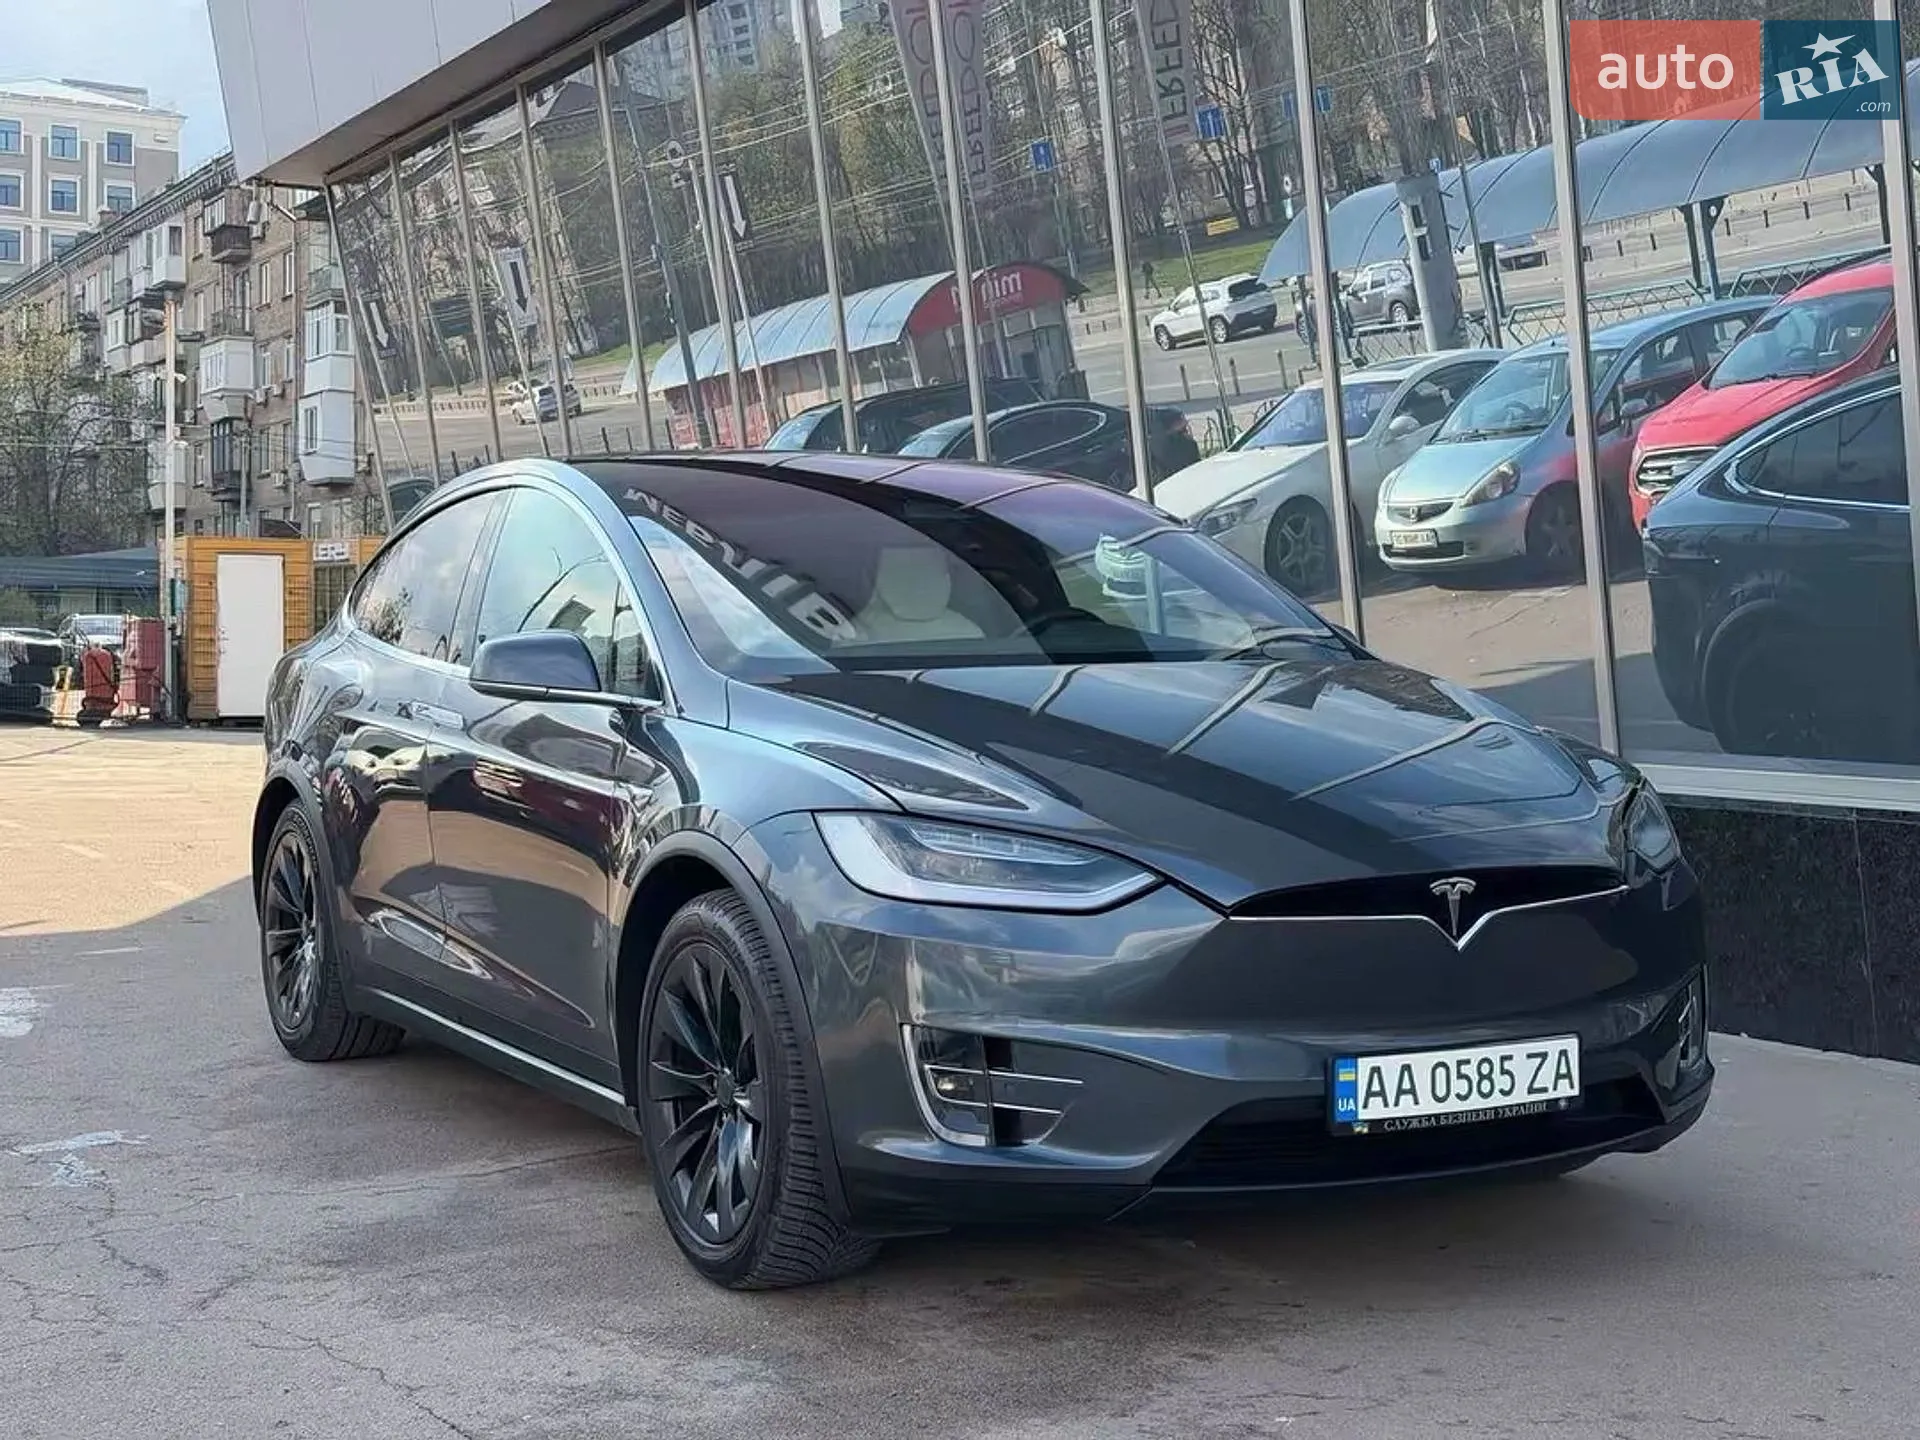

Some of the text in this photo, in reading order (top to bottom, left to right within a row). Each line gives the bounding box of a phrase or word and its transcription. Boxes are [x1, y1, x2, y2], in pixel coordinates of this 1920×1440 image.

[1362, 1049, 1575, 1109] AA 0585 ZA
[1338, 1098, 1356, 1112] UA
[1384, 1116, 1437, 1131] СЛУЖБА
[1439, 1109, 1495, 1125] БЕЗПЕКИ
